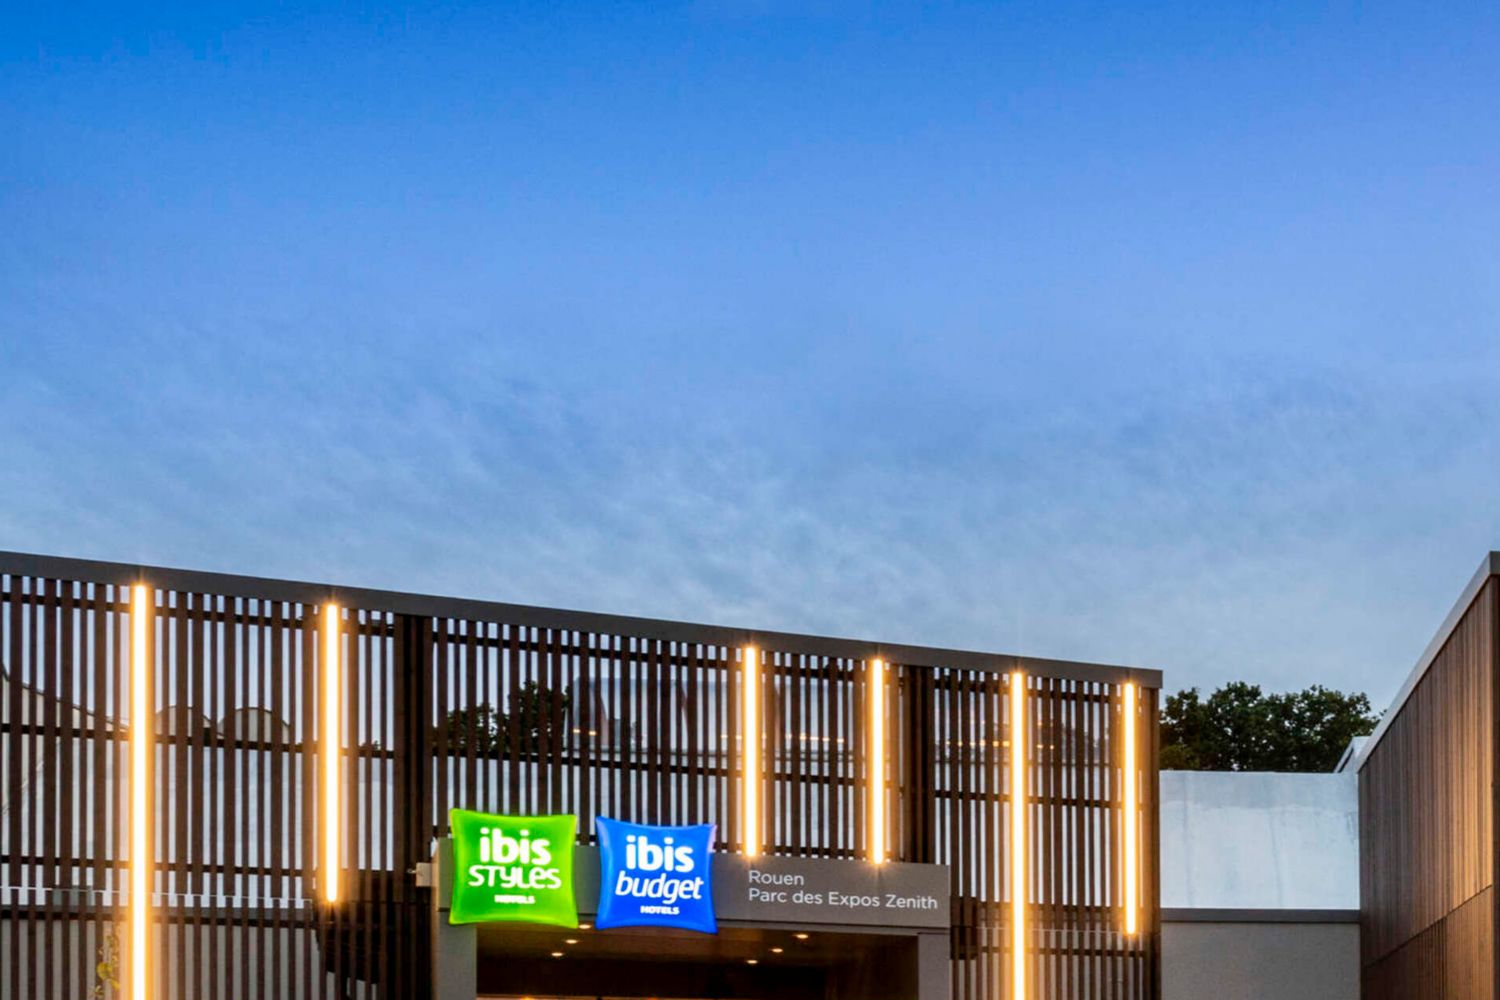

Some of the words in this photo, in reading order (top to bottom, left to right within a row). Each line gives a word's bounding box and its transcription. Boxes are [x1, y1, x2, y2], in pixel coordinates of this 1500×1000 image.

[480, 827, 552, 866] ibis
[626, 835, 695, 872] ibis
[615, 871, 704, 905] budget
[749, 870, 804, 886] Rouen
[641, 905, 680, 915] HOTELS
[749, 888, 787, 903] Parc
[792, 891, 823, 905] des
[828, 892, 880, 908] Expos
[885, 894, 938, 910] Zenith
